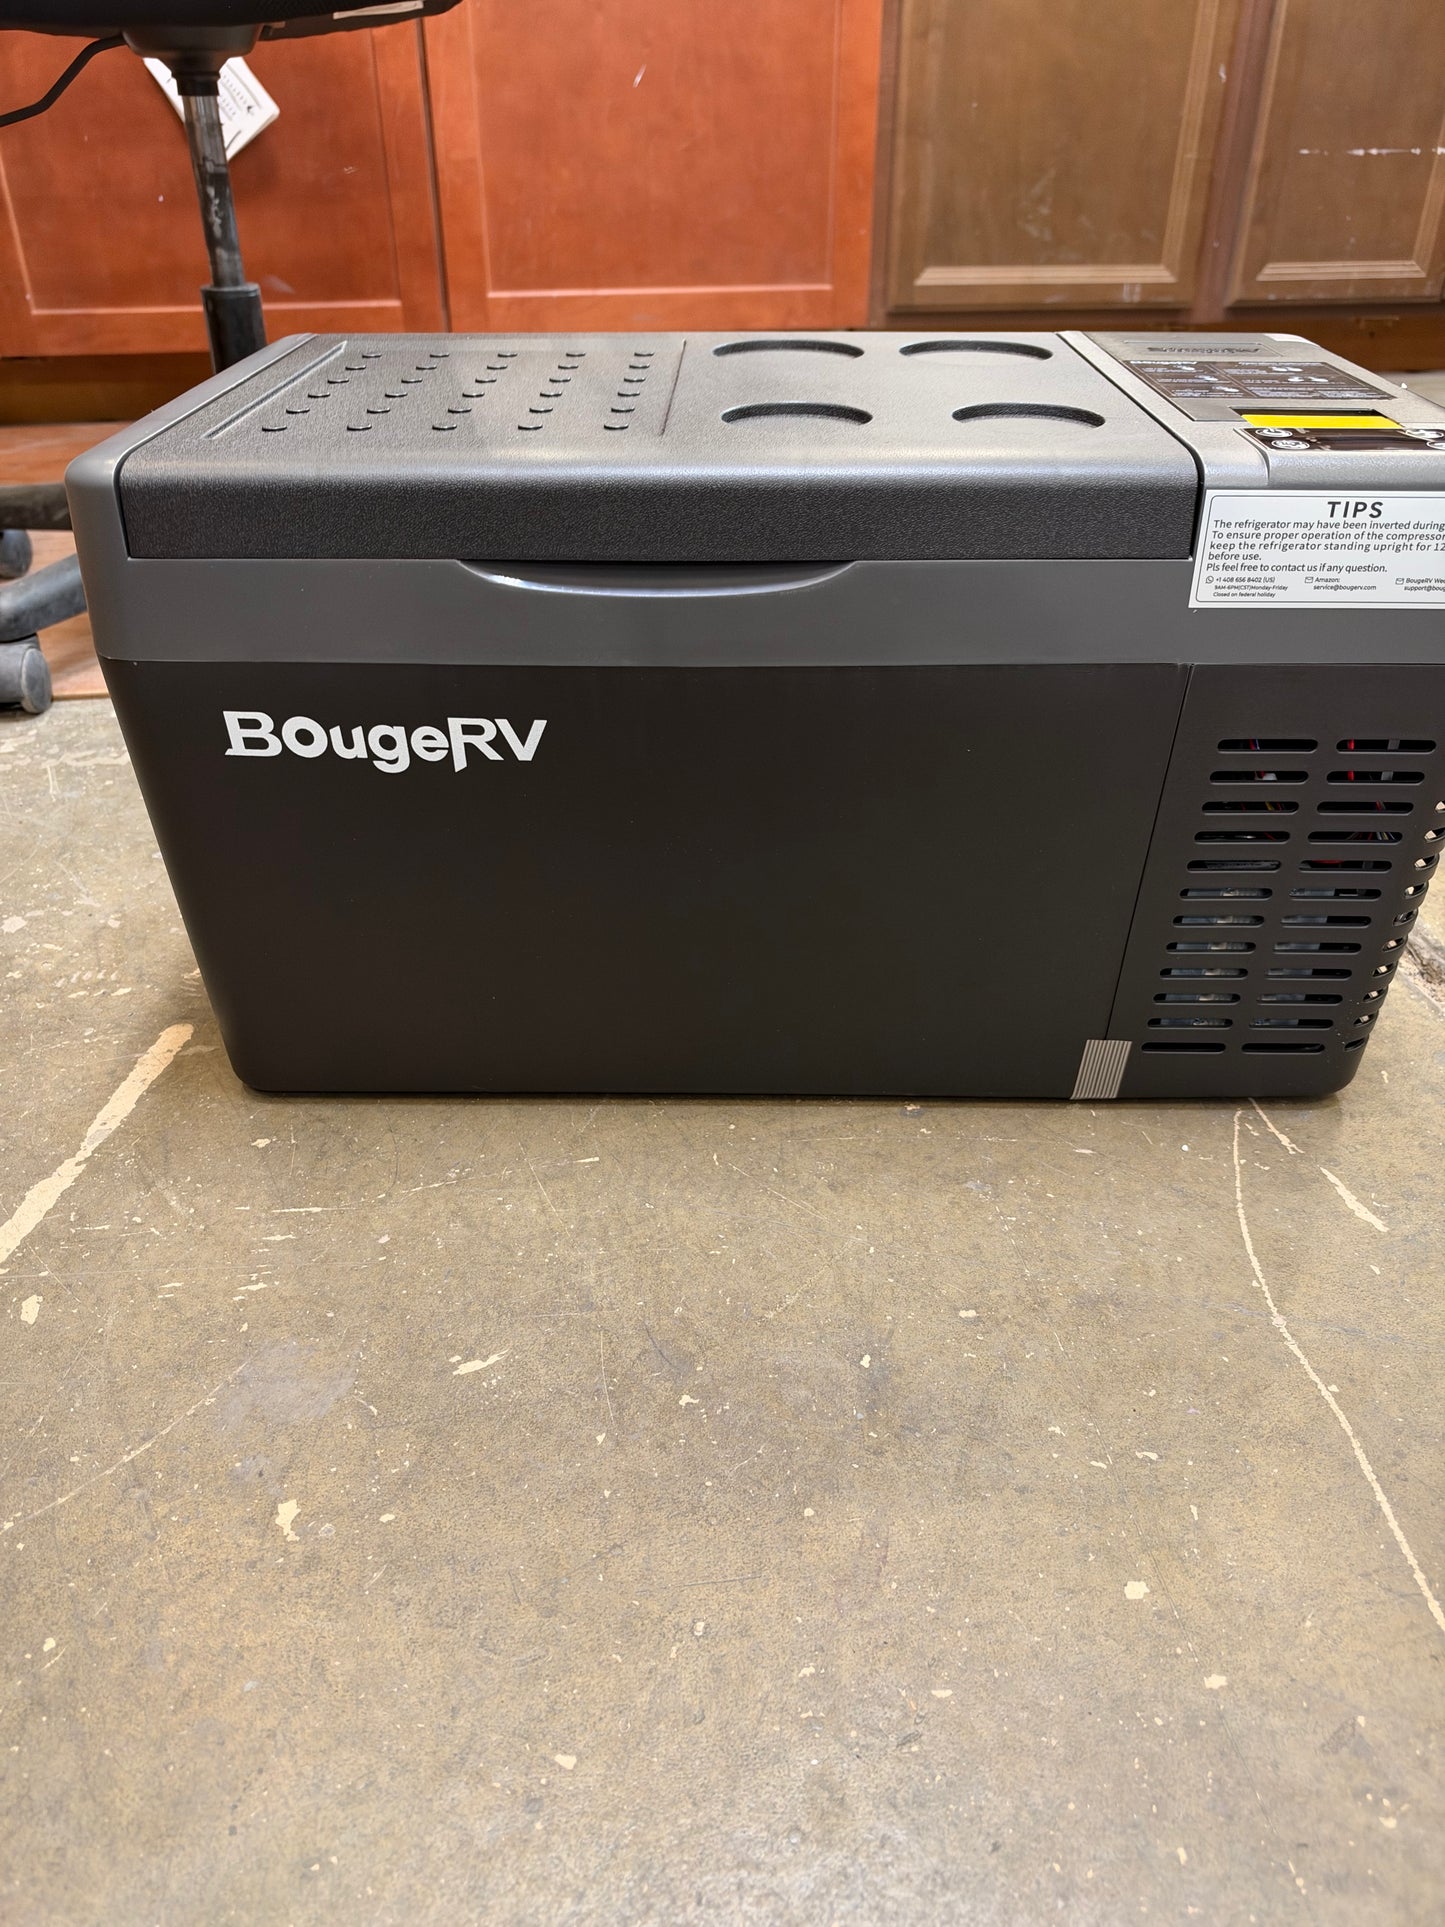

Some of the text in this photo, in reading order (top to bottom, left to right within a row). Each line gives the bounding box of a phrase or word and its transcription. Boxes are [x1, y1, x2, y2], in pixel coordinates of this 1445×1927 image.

[1327, 501, 1384, 518] TIPS
[1213, 520, 1445, 532] The refrigerator may have been inverted during
[1212, 530, 1224, 539] To
[1263, 532, 1300, 541] proper
[1301, 531, 1352, 541] operation
[1354, 531, 1366, 540] of
[1366, 531, 1385, 540] the
[1210, 541, 1236, 552] keep
[1238, 542, 1256, 550] the
[1258, 541, 1322, 552] refrigerator
[1324, 542, 1371, 553] standing
[1373, 542, 1414, 553] upright
[1416, 542, 1432, 551] for
[1208, 552, 1240, 560] before
[1206, 563, 1220, 572] Pls
[1222, 562, 1238, 572] feel
[1240, 562, 1258, 572] free
[1260, 564, 1270, 572] to
[1270, 564, 1305, 572] contact
[1319, 563, 1326, 572] if
[1326, 564, 1344, 574] any
[1345, 564, 1388, 574] question.
